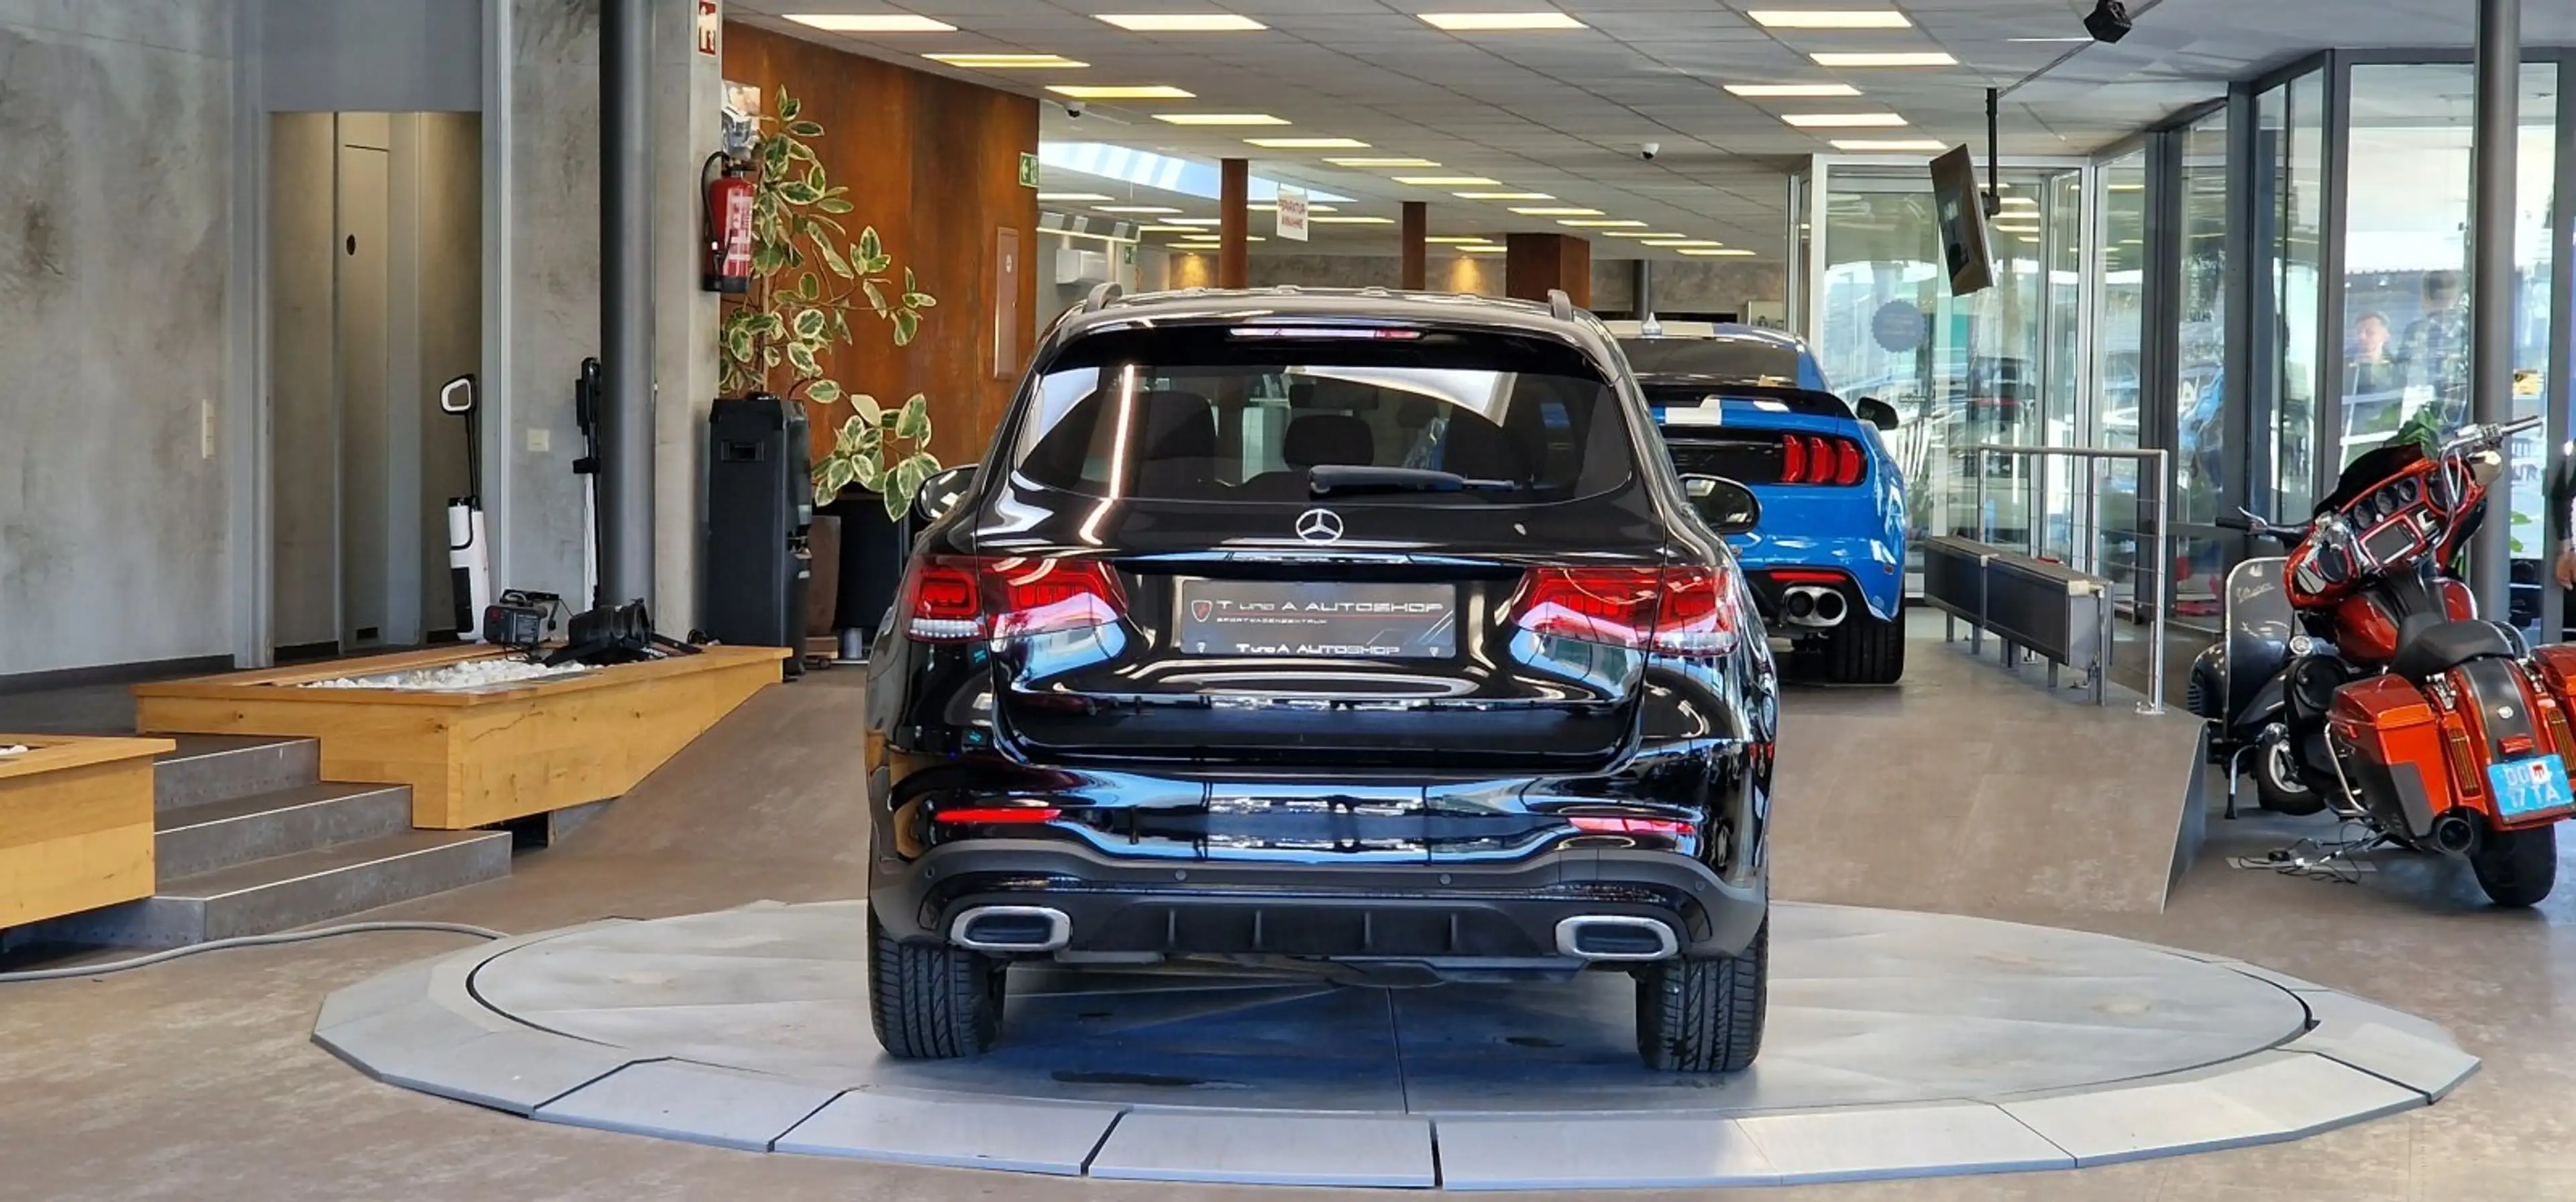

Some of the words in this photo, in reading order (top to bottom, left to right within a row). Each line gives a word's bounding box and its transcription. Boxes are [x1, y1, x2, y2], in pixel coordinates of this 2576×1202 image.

[1216, 600, 1233, 610] T
[1281, 601, 1297, 612] A
[1305, 602, 1444, 613] AUTOSHOP
[1296, 644, 1401, 656] AUTOSHOP
